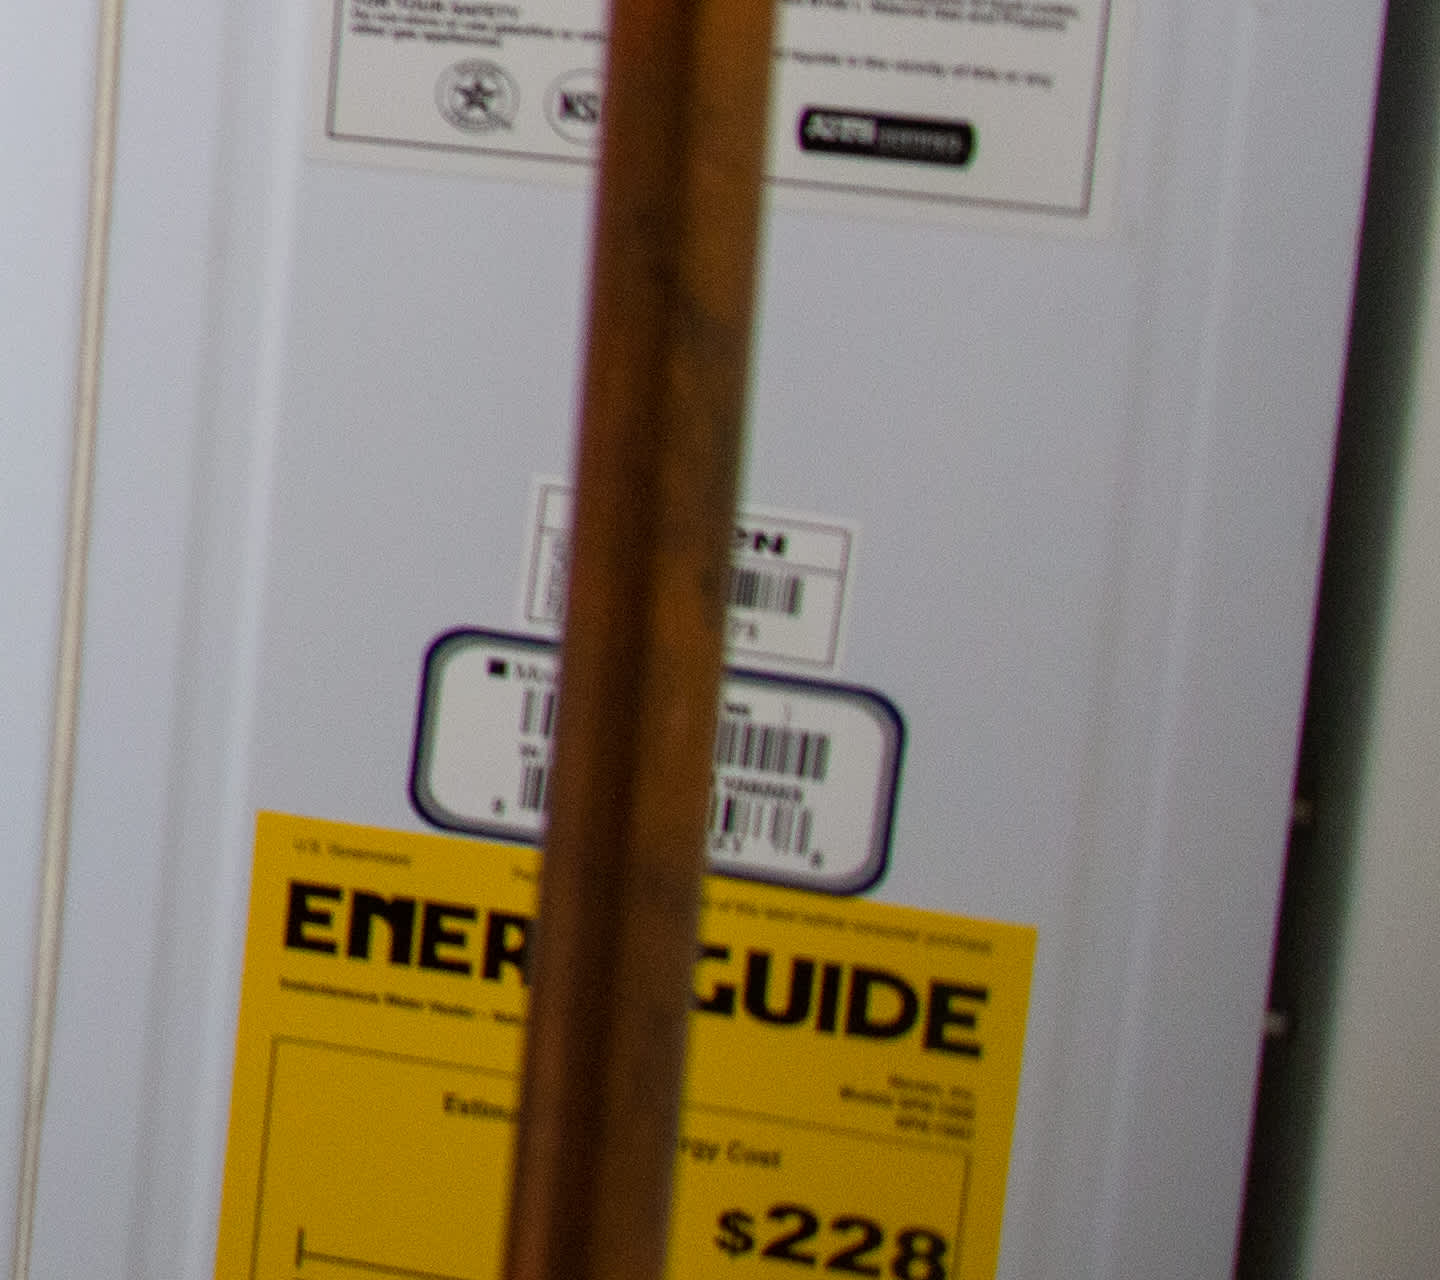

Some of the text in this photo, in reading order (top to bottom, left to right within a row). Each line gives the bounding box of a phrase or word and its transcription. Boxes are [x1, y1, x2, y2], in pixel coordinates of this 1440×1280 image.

[284, 878, 989, 1061] ENER GUIDE
[442, 1091, 518, 1124] Estim
[714, 1202, 950, 1280] $228
